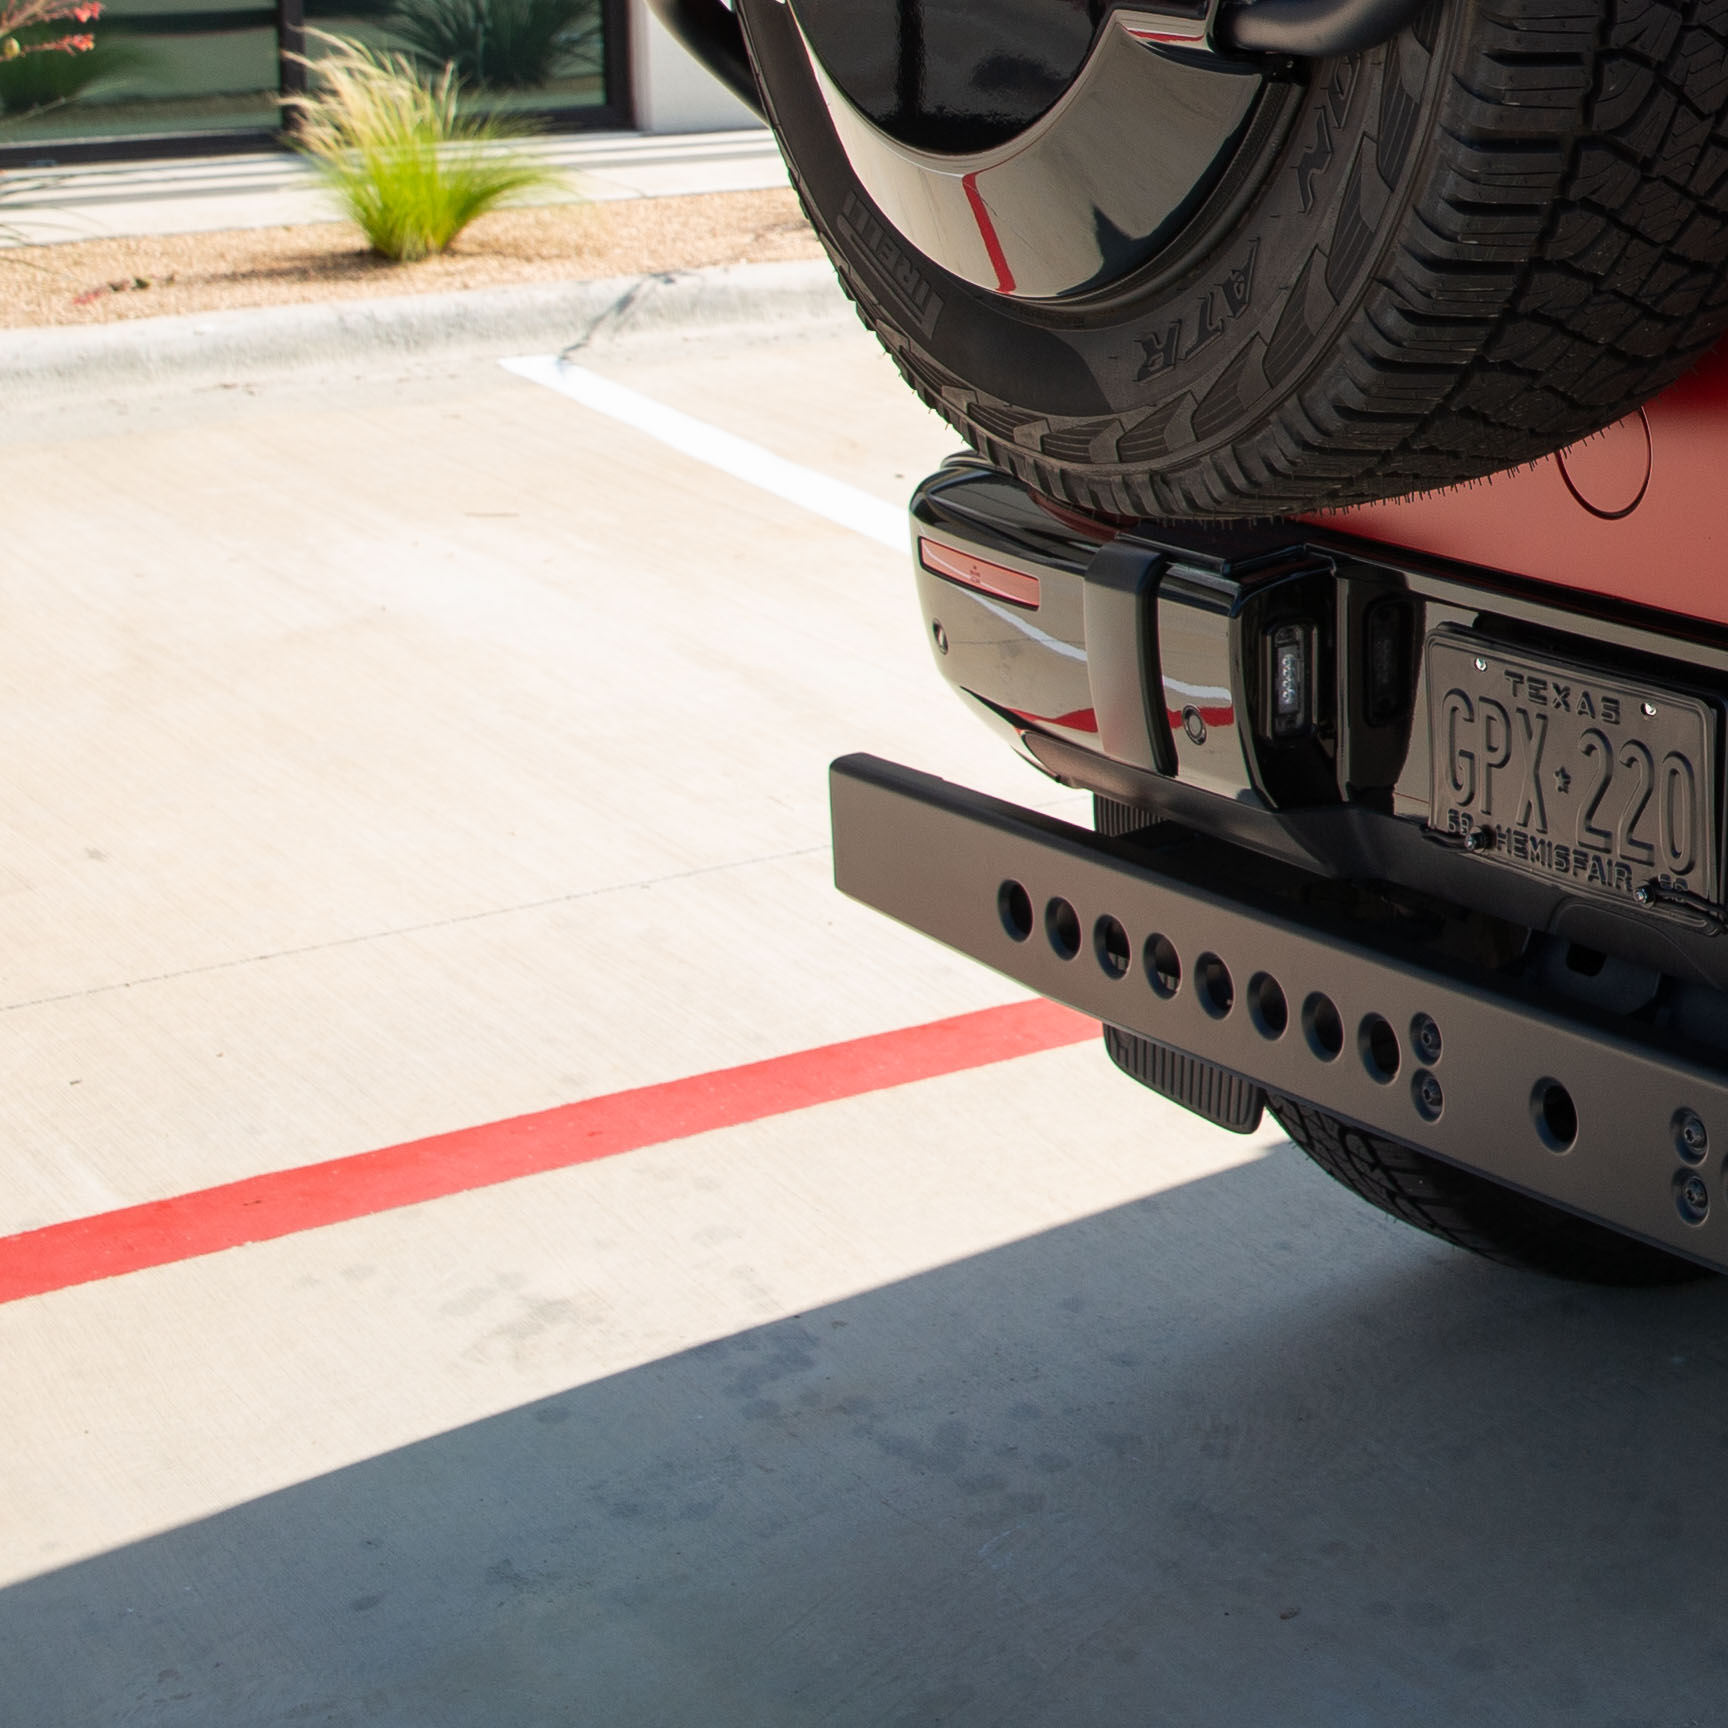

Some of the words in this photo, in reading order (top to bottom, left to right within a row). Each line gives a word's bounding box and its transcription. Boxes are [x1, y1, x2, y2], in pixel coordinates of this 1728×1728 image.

[835, 191, 945, 338] PIRELLI
[1504, 670, 1621, 725] TEXAS
[1442, 687, 1549, 834] GPX
[1575, 728, 1697, 876] 220
[1496, 823, 1634, 891] HEMISFAIR
